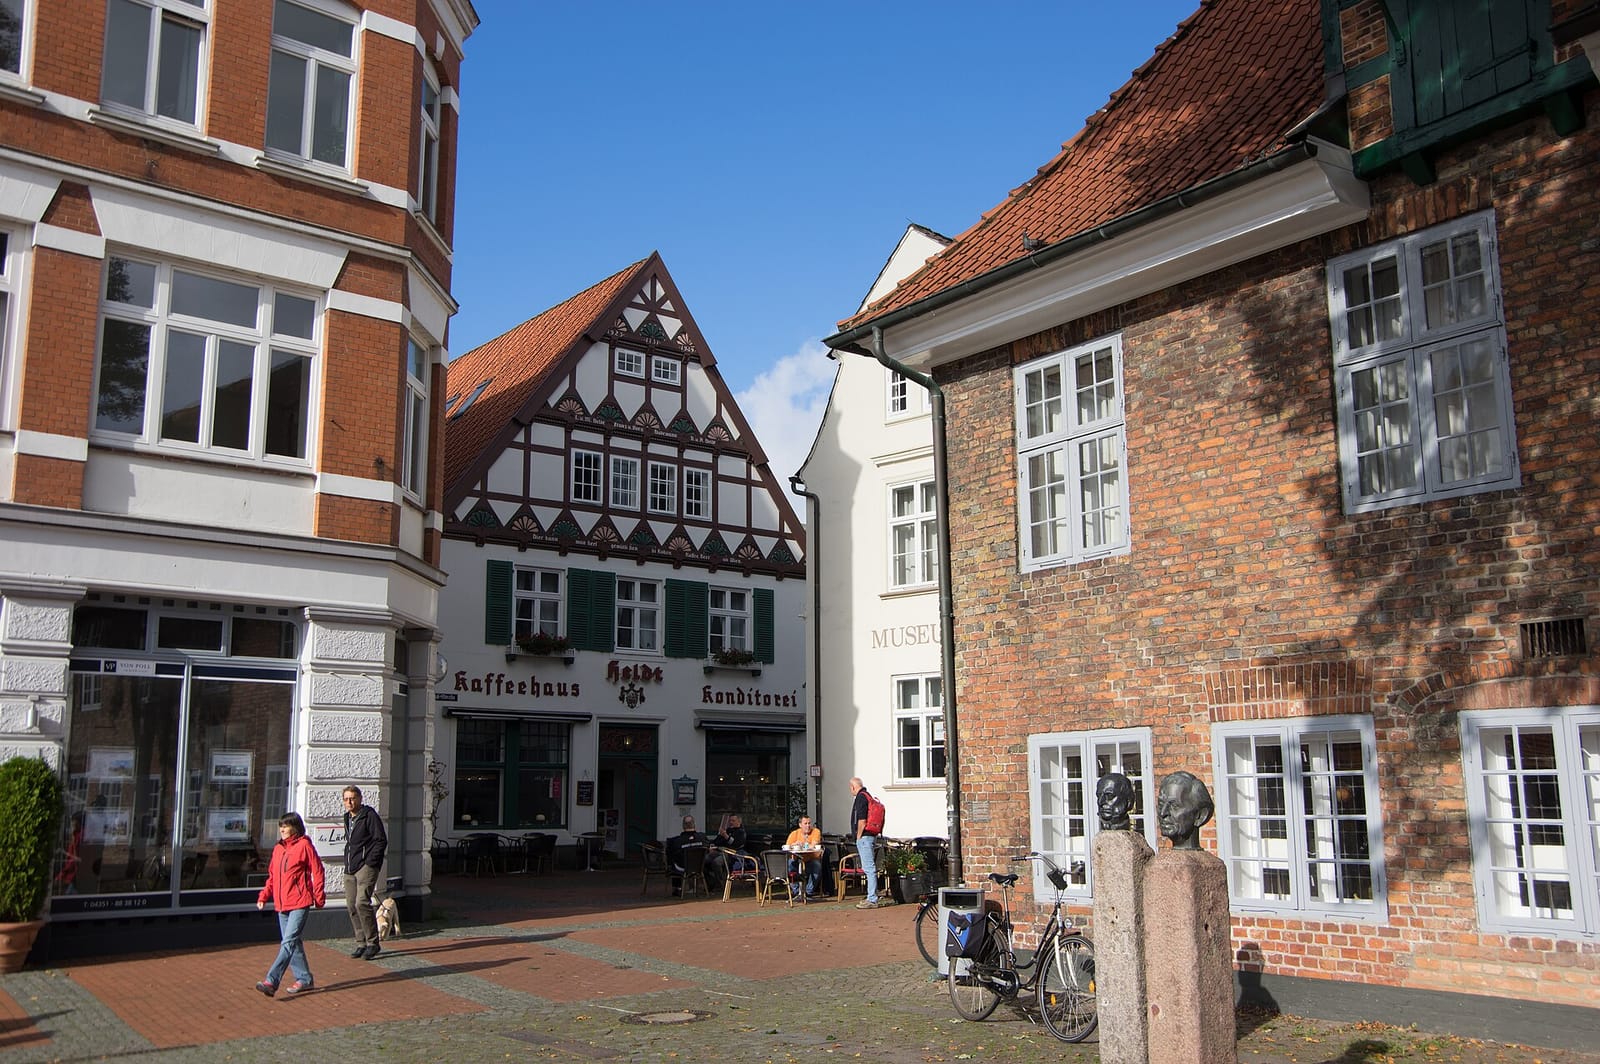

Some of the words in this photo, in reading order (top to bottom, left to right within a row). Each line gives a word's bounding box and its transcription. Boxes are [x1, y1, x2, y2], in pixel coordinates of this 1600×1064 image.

[454, 670, 580, 698] Kaffeehaus
[606, 660, 663, 684] Heldt
[702, 685, 797, 707] Konditorei
